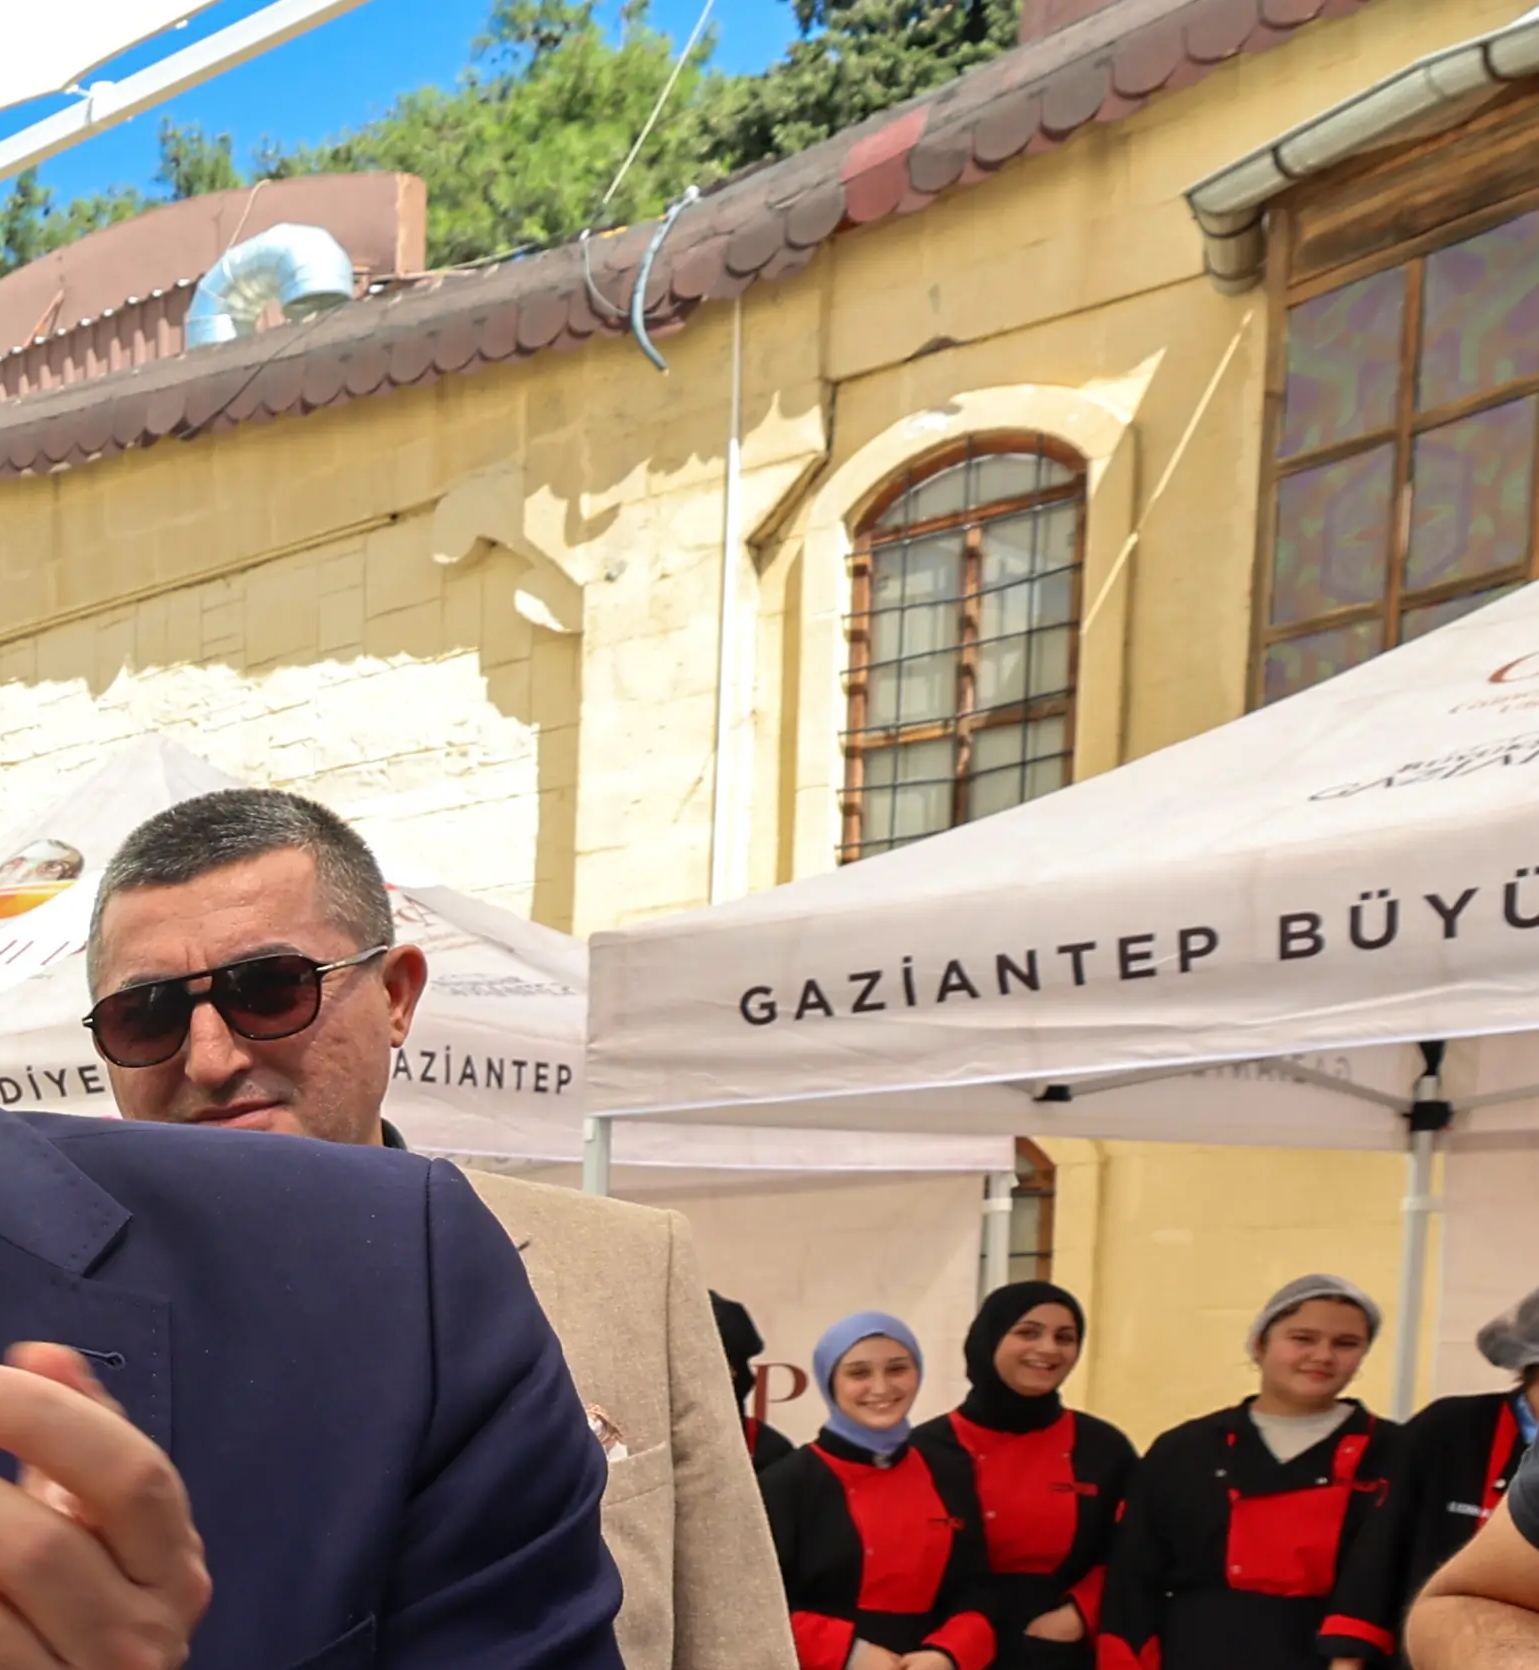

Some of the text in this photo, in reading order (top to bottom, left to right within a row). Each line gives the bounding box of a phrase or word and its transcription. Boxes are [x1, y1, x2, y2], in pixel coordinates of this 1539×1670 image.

[739, 866, 1539, 1026] GAZİANTEP BÜYÜ
[393, 1046, 572, 1094] AZİANTEP
